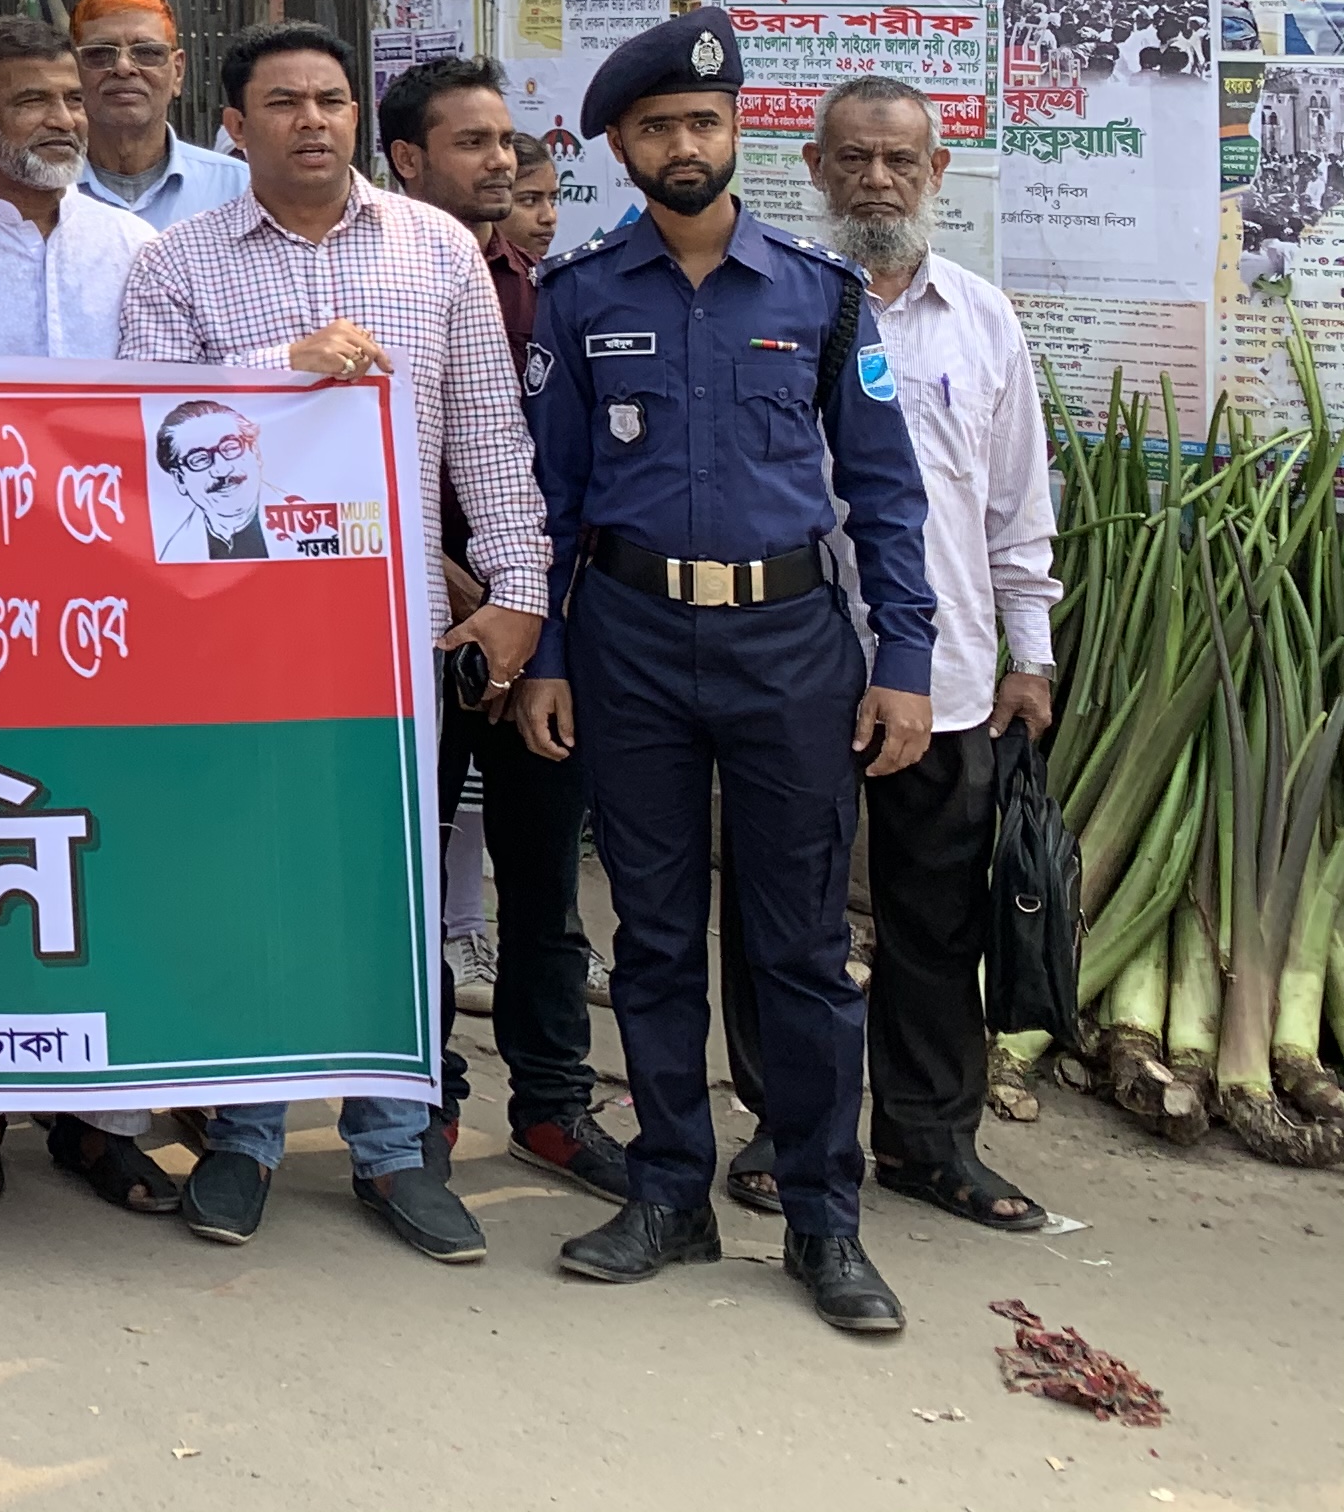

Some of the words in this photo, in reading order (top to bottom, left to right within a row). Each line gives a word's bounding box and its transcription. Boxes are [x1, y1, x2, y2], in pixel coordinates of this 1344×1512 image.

[728, 6, 829, 35] উরস
[837, 5, 981, 37] শরীফ
[754, 36, 791, 53] মাওলানা
[841, 35, 881, 56] সাইয়েদ
[885, 35, 920, 56] জালাল
[923, 30, 946, 61] নূরী
[803, 55, 831, 69] দিবস
[957, 59, 982, 75] মার্চ
[1025, 183, 1053, 198] শহীদ
[1058, 183, 1088, 198] দিবস
[1051, 199, 1061, 210] ও
[1048, 214, 1100, 229] মাতৃভাষা
[1104, 212, 1137, 228] দিবস
[1235, 313, 1267, 323] জনাব
[1235, 324, 1267, 335] জনাব
[1235, 338, 1267, 348] জনাব
[1056, 360, 1083, 372] আলী
[57, 463, 125, 542] দেব
[341, 502, 382, 522] MUJIB
[264, 495, 339, 543] মুজিব
[341, 523, 384, 556] 100
[60, 597, 129, 678] নেব
